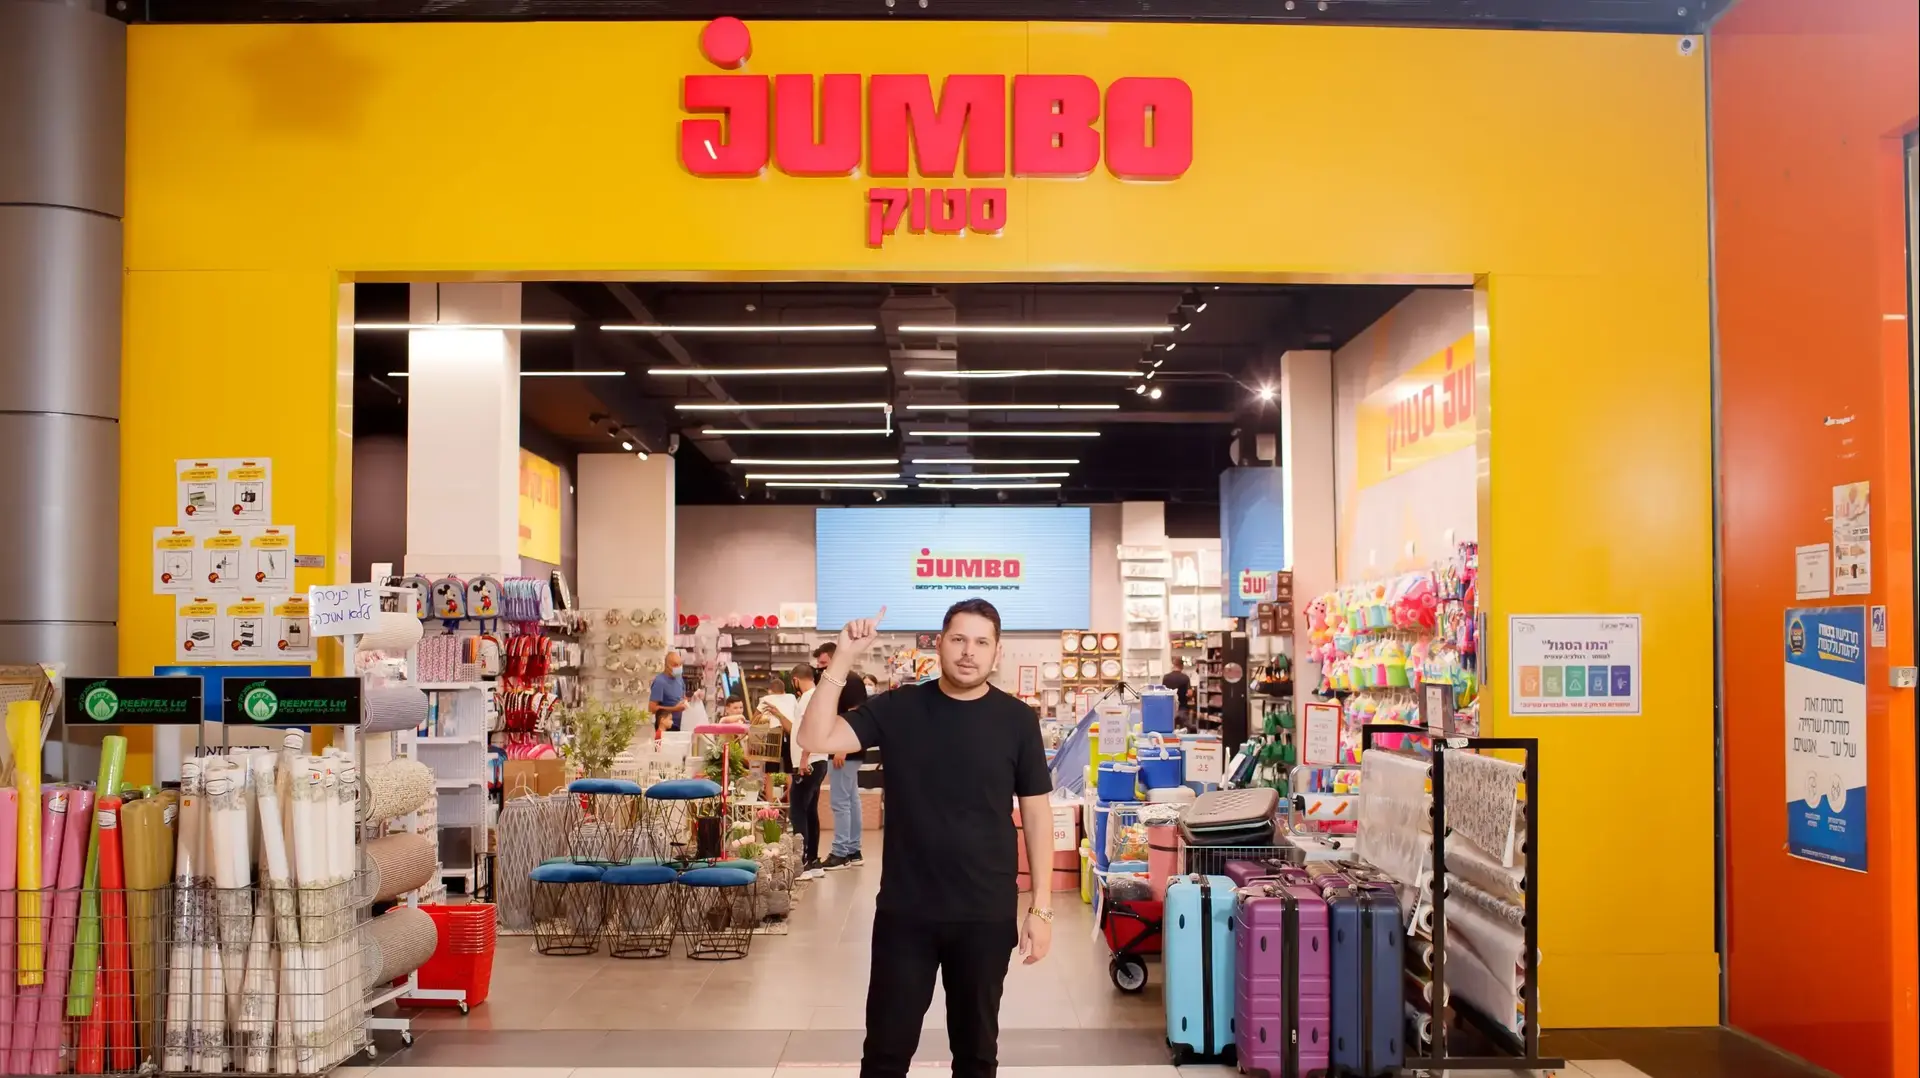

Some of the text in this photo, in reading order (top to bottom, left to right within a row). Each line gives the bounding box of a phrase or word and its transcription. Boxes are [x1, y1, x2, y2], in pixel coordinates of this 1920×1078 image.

[678, 16, 1194, 181] JUMBO
[865, 187, 1008, 249] סטוק
[1387, 346, 1477, 472] JU סטוק
[916, 547, 1020, 578] JUMBO
[314, 589, 349, 605] כניסה
[170, 699, 188, 708] Ltd
[330, 699, 347, 708] Ltd
[1804, 697, 1844, 714] בחנות זאת
[1798, 717, 1850, 736] מותרת שהייה
[1830, 740, 1842, 757] עד
[1843, 737, 1857, 758] של
